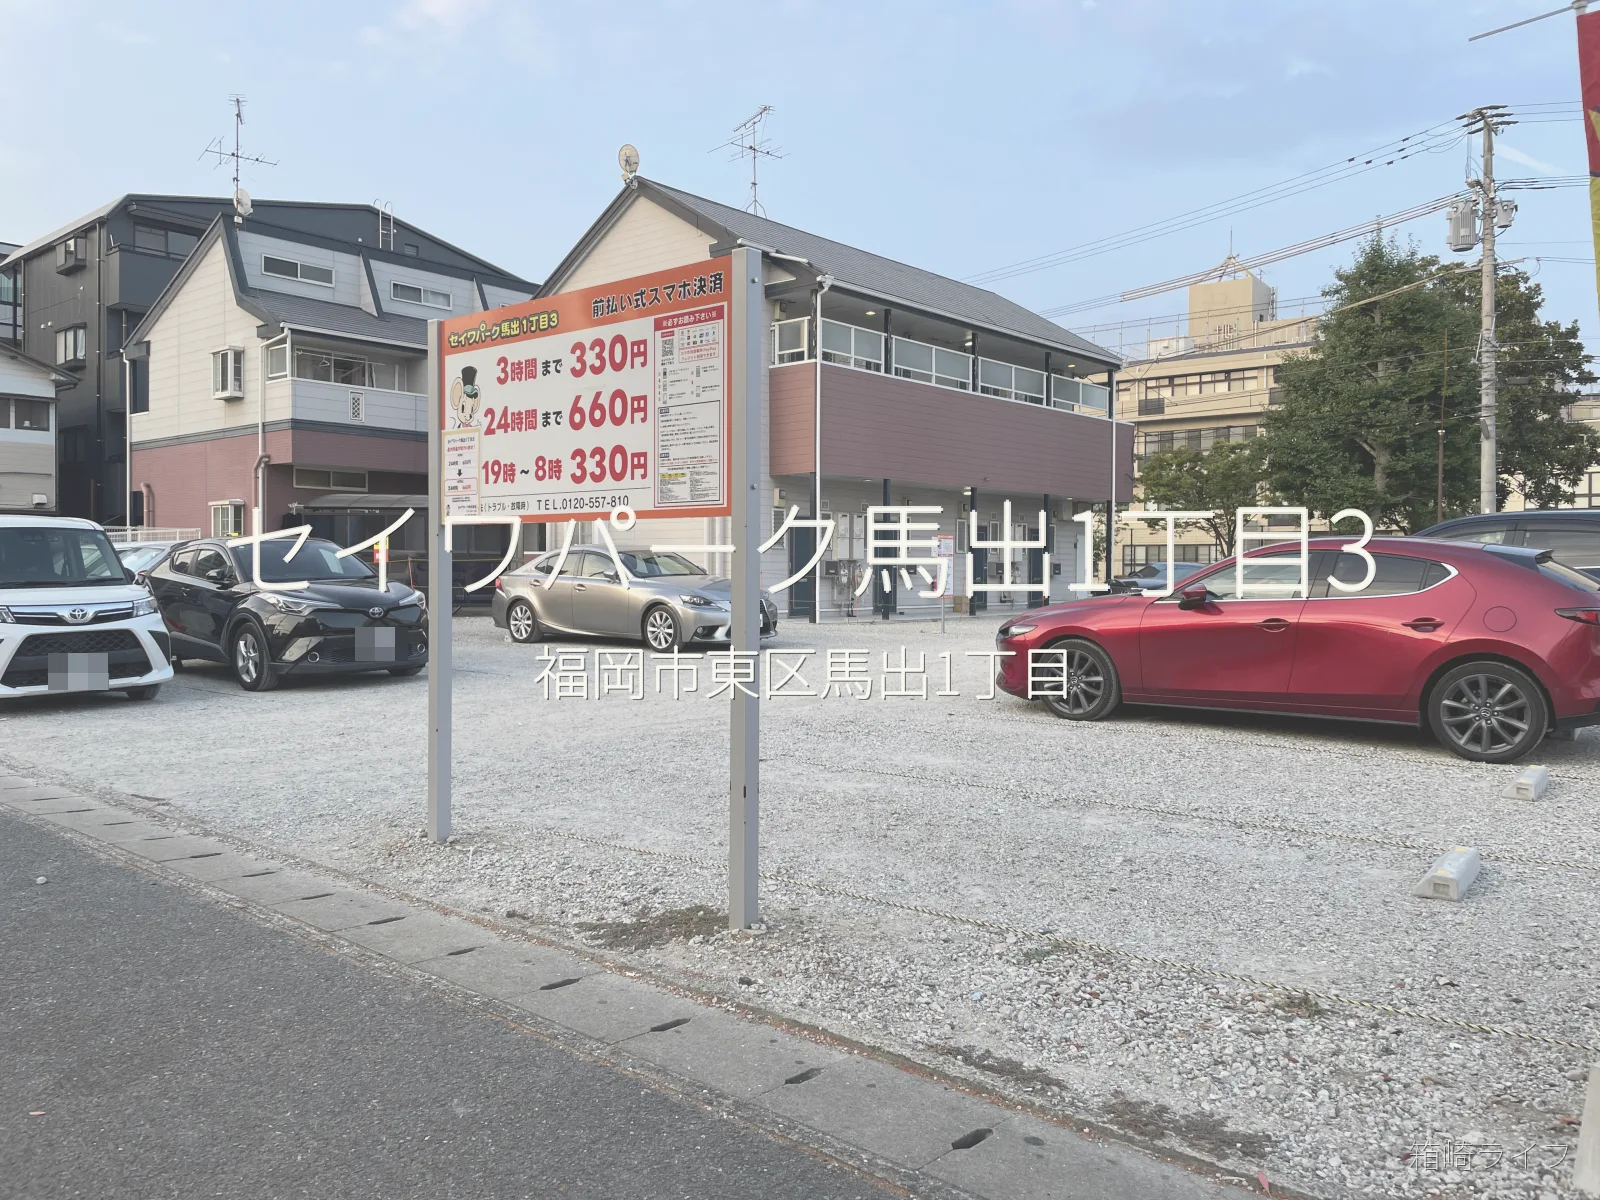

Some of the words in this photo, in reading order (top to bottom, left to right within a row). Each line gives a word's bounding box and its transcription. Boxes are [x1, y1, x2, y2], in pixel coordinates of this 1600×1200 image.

[592, 272, 724, 318] 前払い式スマホ決済
[449, 311, 558, 347] セイワパーク馬出1丁目3
[570, 334, 648, 378] 330円
[568, 389, 648, 431] 660円
[570, 445, 648, 485] 330円
